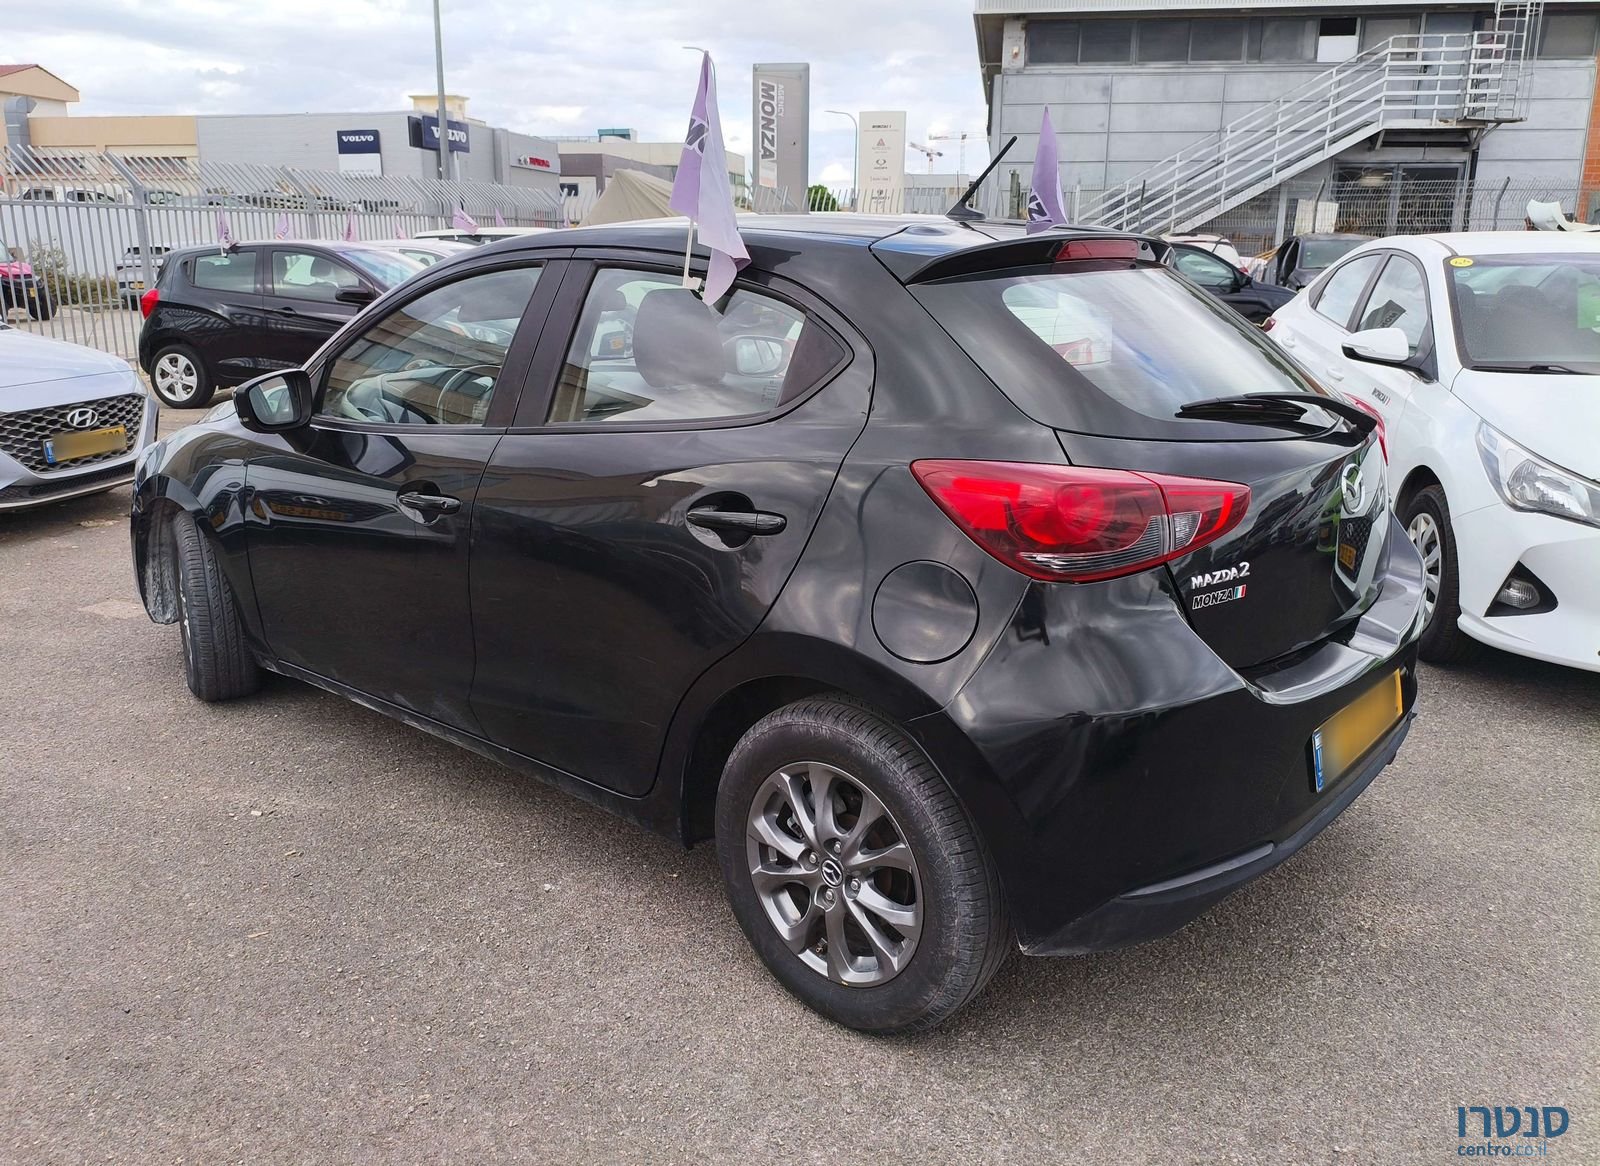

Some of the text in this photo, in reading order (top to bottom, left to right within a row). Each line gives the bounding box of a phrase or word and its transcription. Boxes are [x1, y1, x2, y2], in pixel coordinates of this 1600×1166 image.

[760, 81, 776, 160] MONZA
[430, 126, 467, 143] VLVO
[1192, 588, 1234, 610] MONZA
